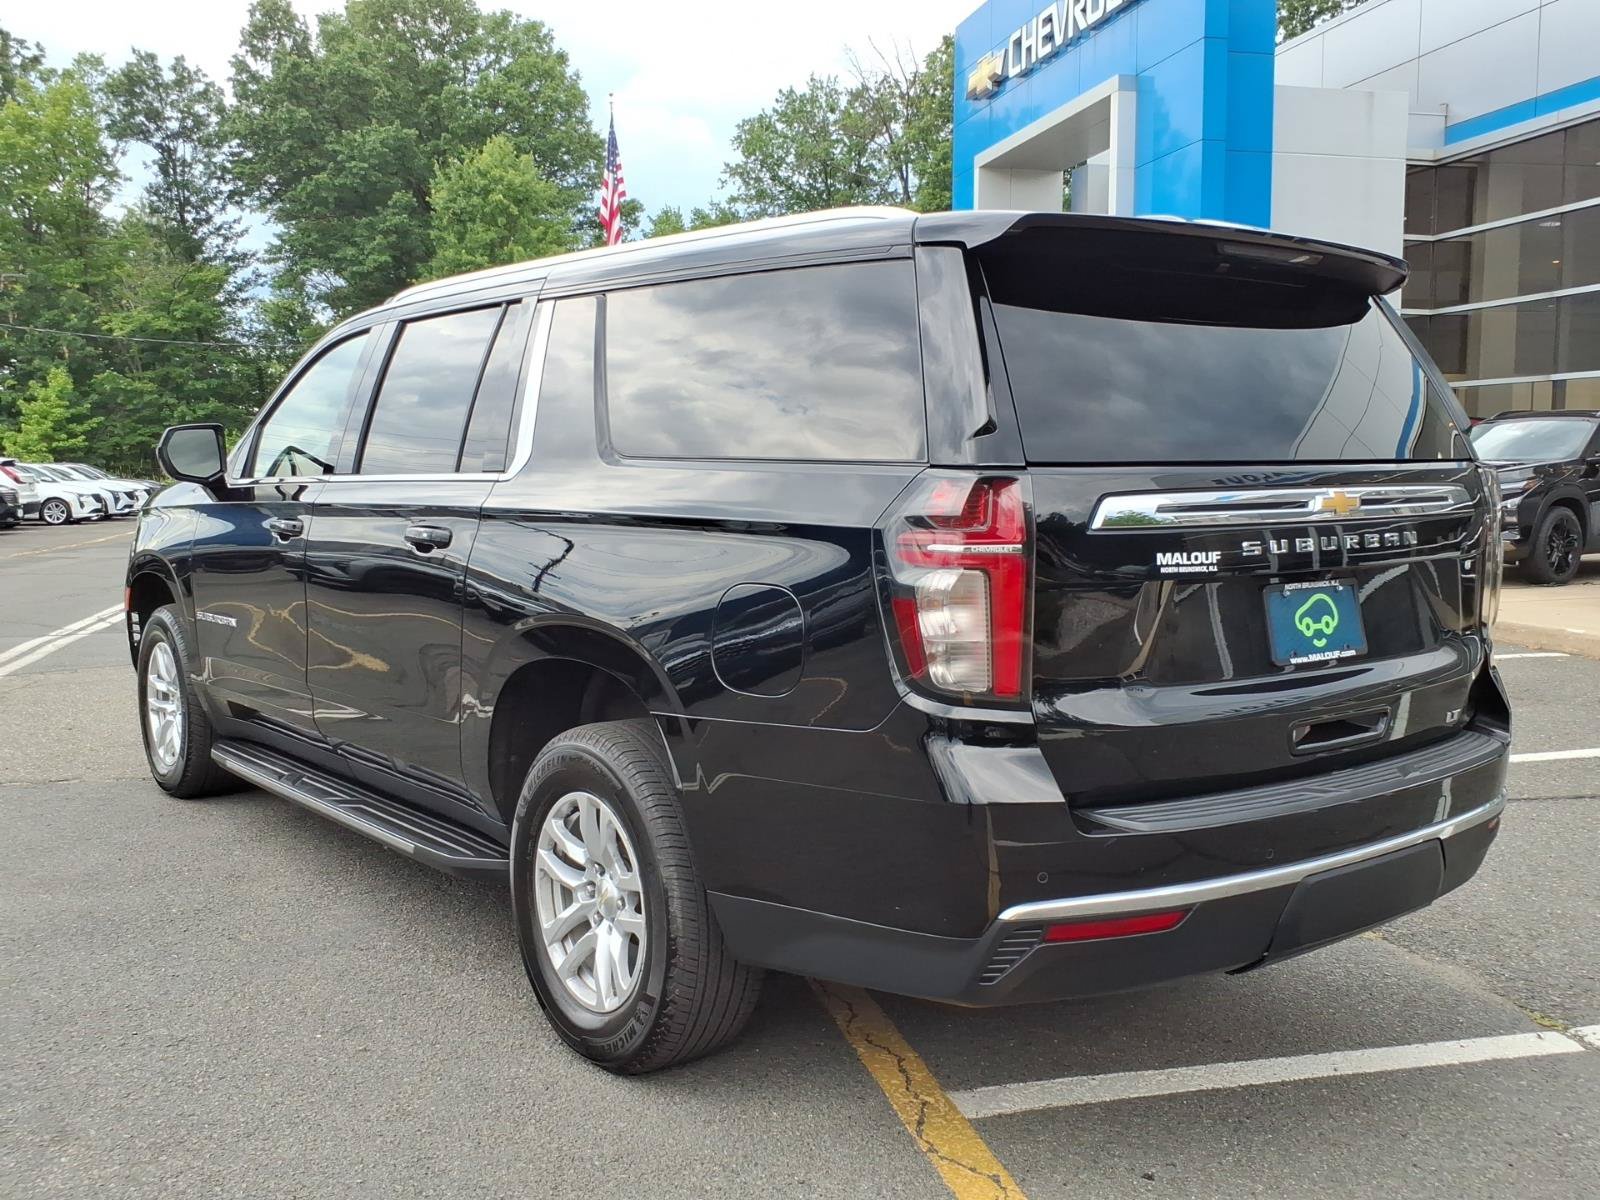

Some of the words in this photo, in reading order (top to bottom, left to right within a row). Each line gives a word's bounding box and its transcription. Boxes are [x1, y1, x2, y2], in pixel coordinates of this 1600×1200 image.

[1009, 0, 1125, 78] CHEVRO
[1242, 531, 1417, 556] SUBURBAN
[1156, 551, 1221, 566] MALOUF
[1446, 709, 1461, 723] LT
[527, 754, 567, 794] MICHELIN
